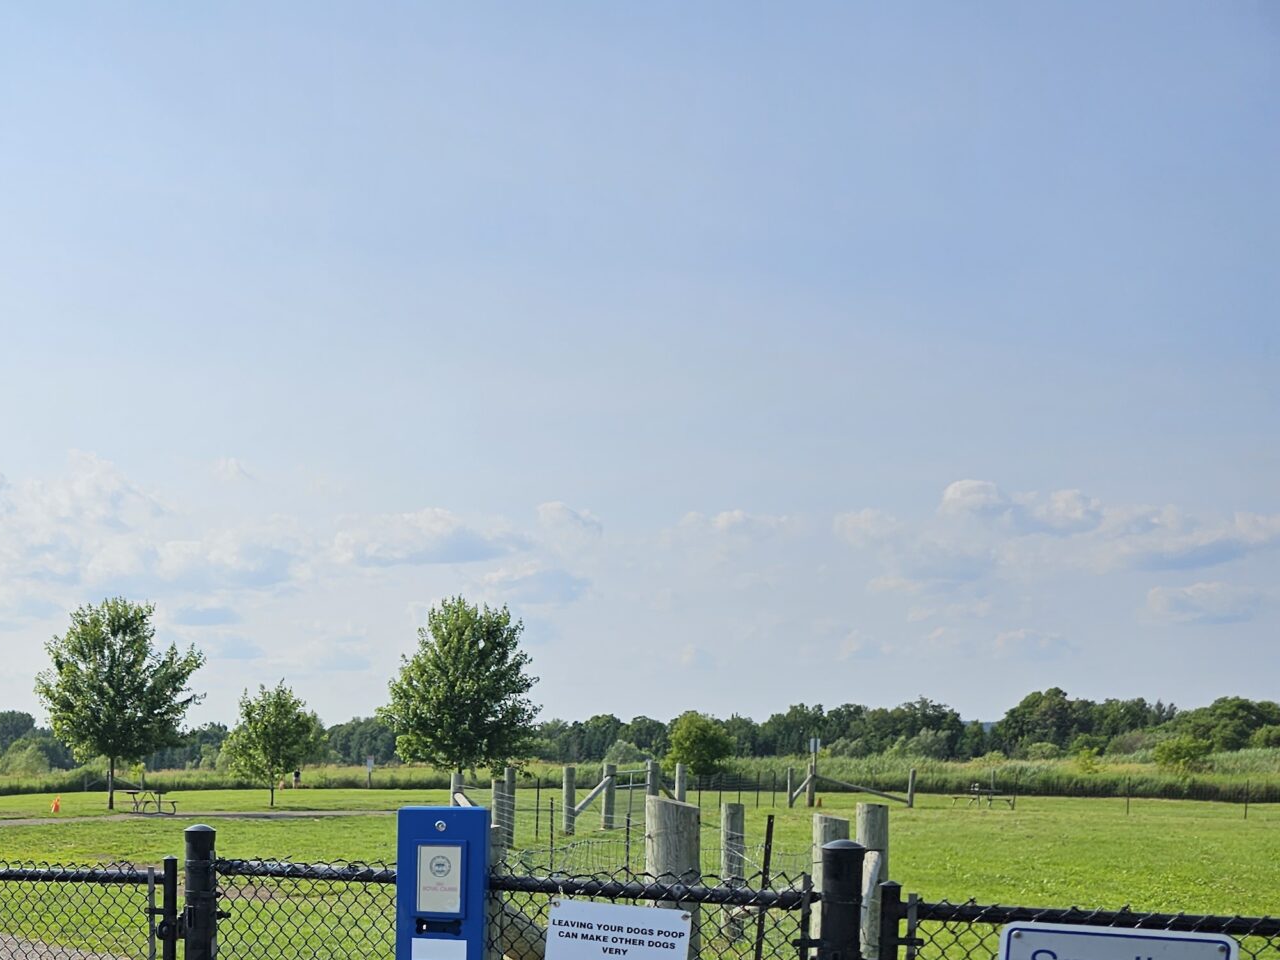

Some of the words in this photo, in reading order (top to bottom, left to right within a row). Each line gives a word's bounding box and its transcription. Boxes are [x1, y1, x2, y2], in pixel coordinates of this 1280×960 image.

[552, 918, 594, 930] LEAVING
[596, 923, 624, 933] YOUR
[626, 926, 654, 936] DOGS
[657, 929, 685, 939] POOP
[558, 930, 578, 940] CAN
[580, 933, 608, 943] MAKE
[611, 936, 645, 946] OTHER
[647, 940, 676, 950] DOGS
[602, 946, 629, 956] VERY
